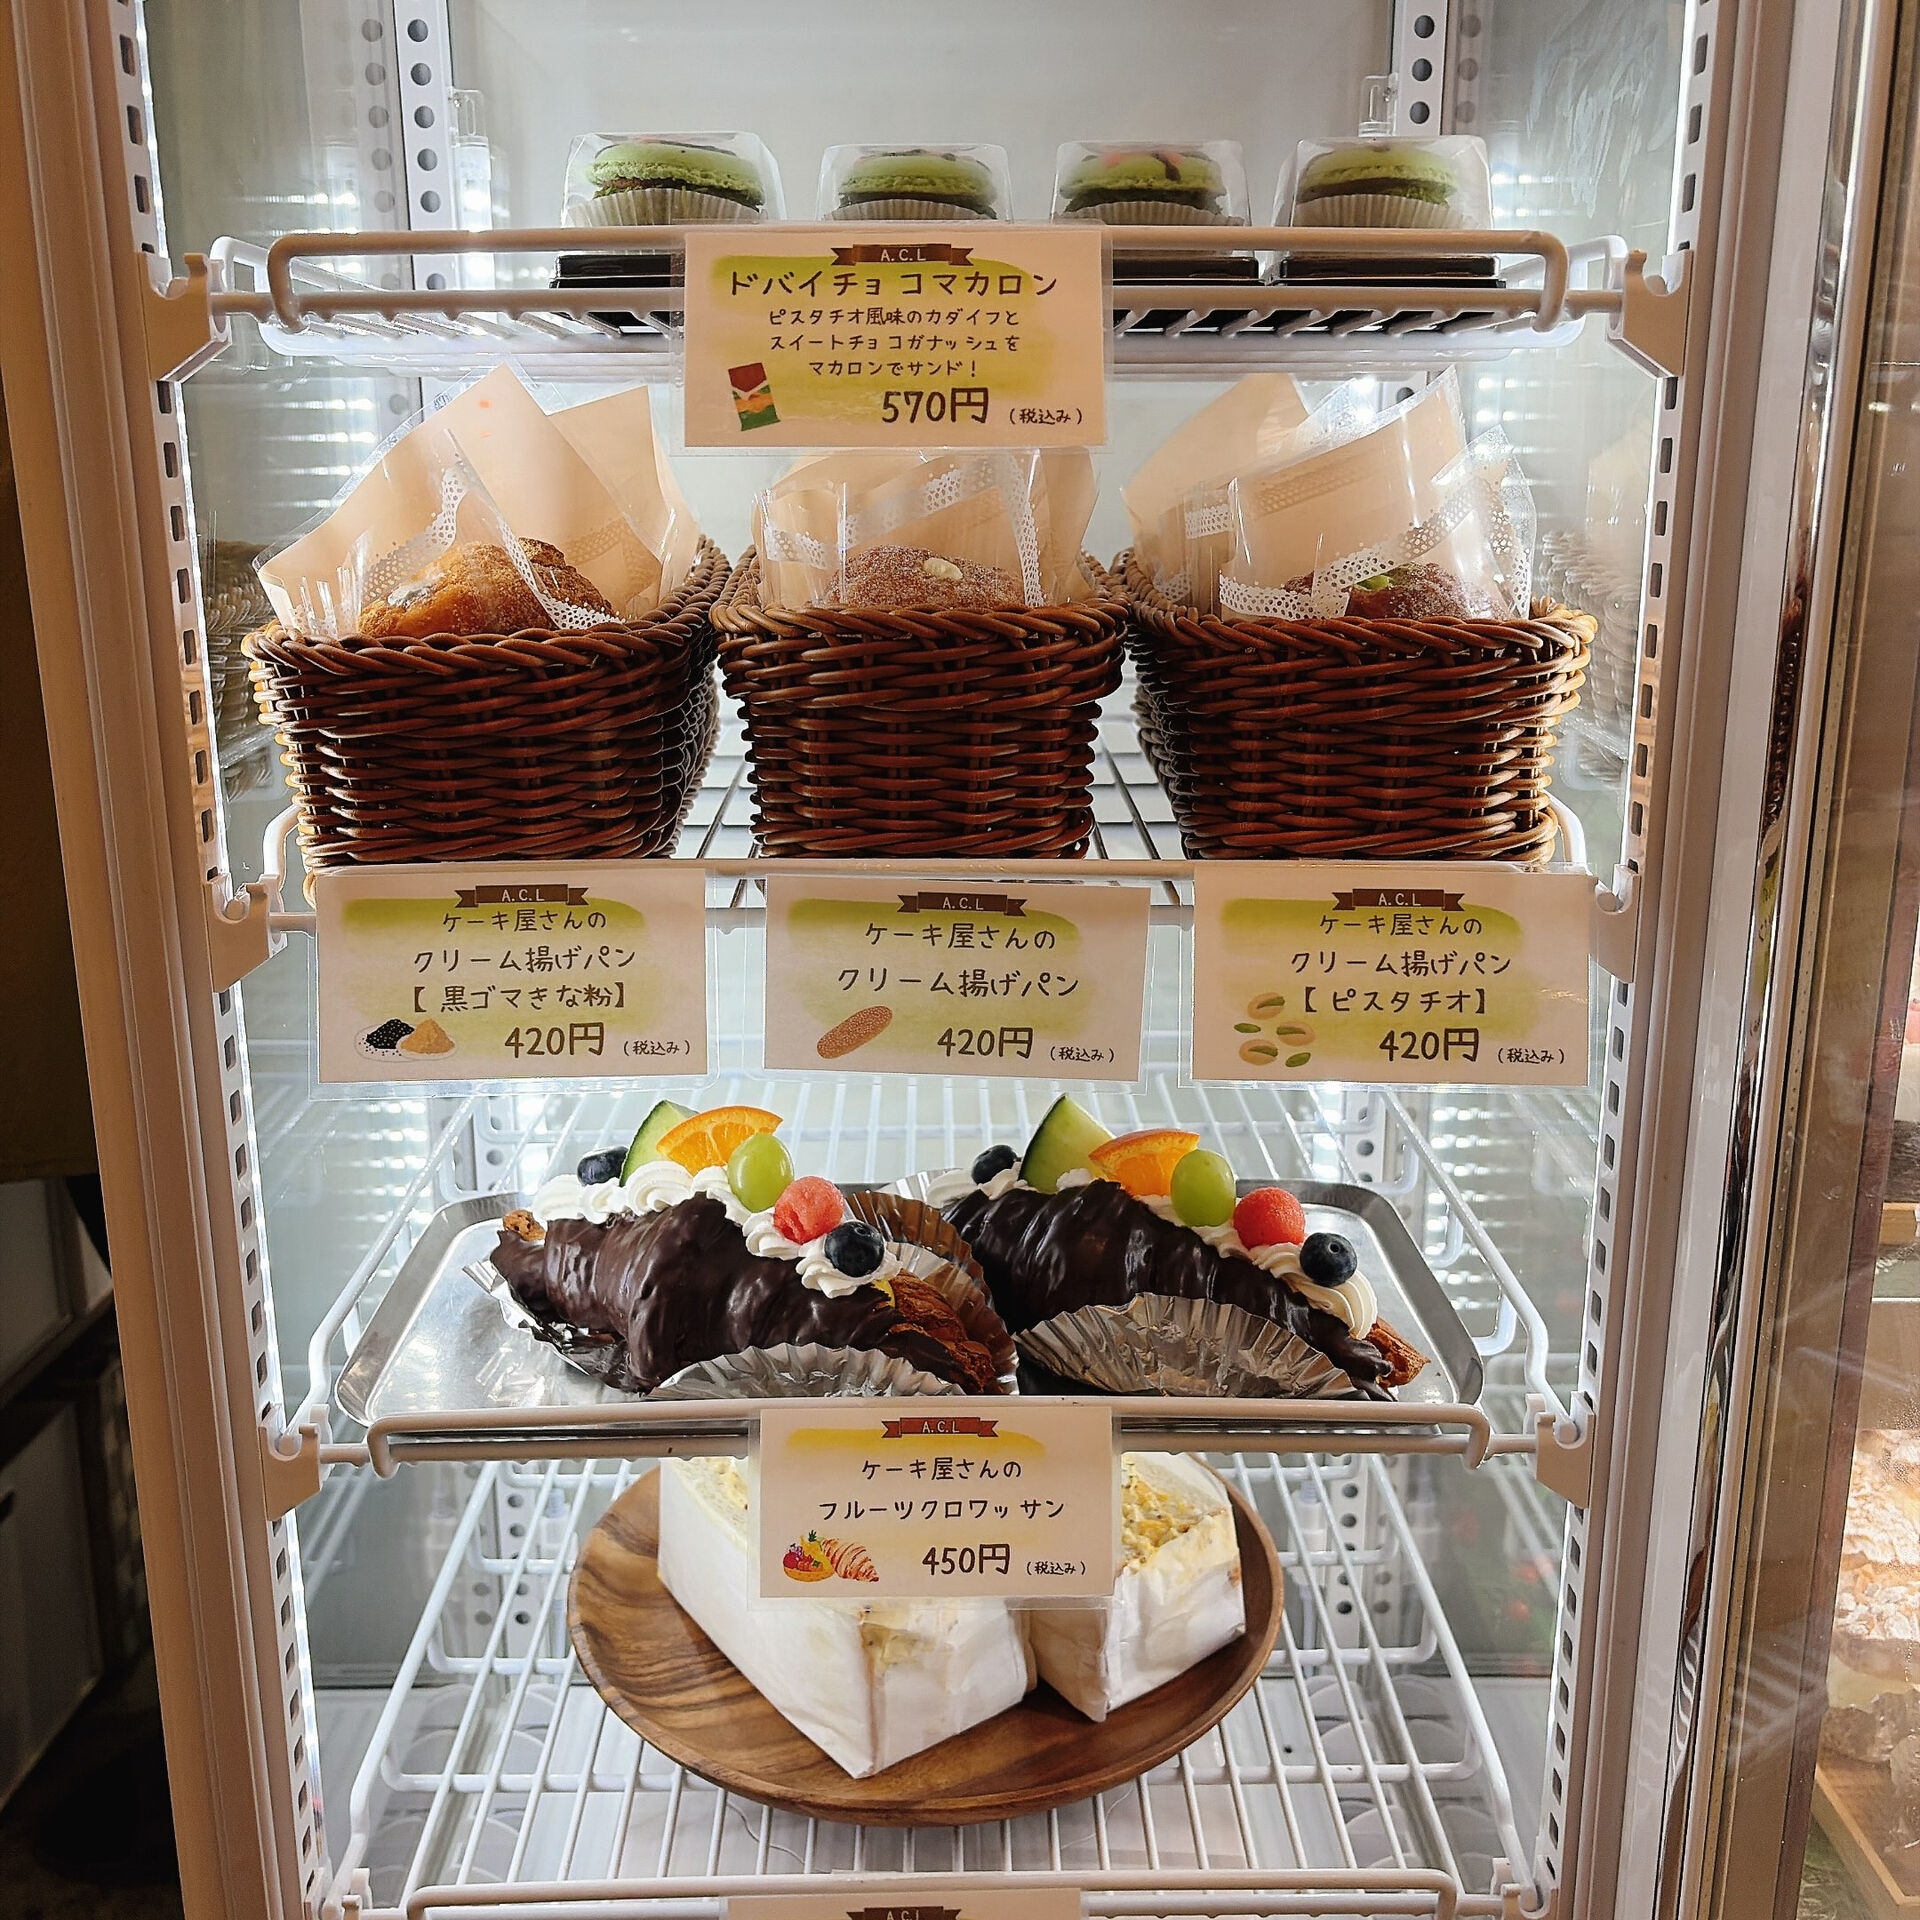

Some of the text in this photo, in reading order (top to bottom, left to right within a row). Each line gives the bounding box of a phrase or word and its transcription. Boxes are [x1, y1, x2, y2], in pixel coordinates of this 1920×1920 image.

[880, 249, 927, 262] A.C.L
[732, 271, 1056, 297] ドバイチョコマカロン
[770, 307, 1018, 325] ピスタチオ風味のカダイフと
[771, 335, 1019, 351] スイートチョコガナッシュを
[882, 387, 988, 423] 570円
[501, 889, 545, 903] A.C.L
[942, 896, 984, 911] A.C.L
[1378, 892, 1422, 907] A.C.L
[443, 909, 606, 932] ケーキ屋さんの
[1320, 914, 1481, 935] ケーキ屋さんの
[866, 921, 1055, 949] ケーキ屋さんの
[415, 945, 635, 973] クリーム揚げパン
[1292, 950, 1510, 977] クリーム揚げパン
[839, 968, 1078, 997] クリーム揚げパン
[505, 1022, 604, 1058] 420円
[937, 1027, 1033, 1059] 420円
[1379, 1028, 1479, 1062] 420円
[921, 1420, 960, 1434] A.C.L
[862, 1457, 1021, 1480] ケーキ屋さんの
[819, 1499, 1063, 1520] フルーツクロワッサン
[922, 1544, 1010, 1575] 450円
